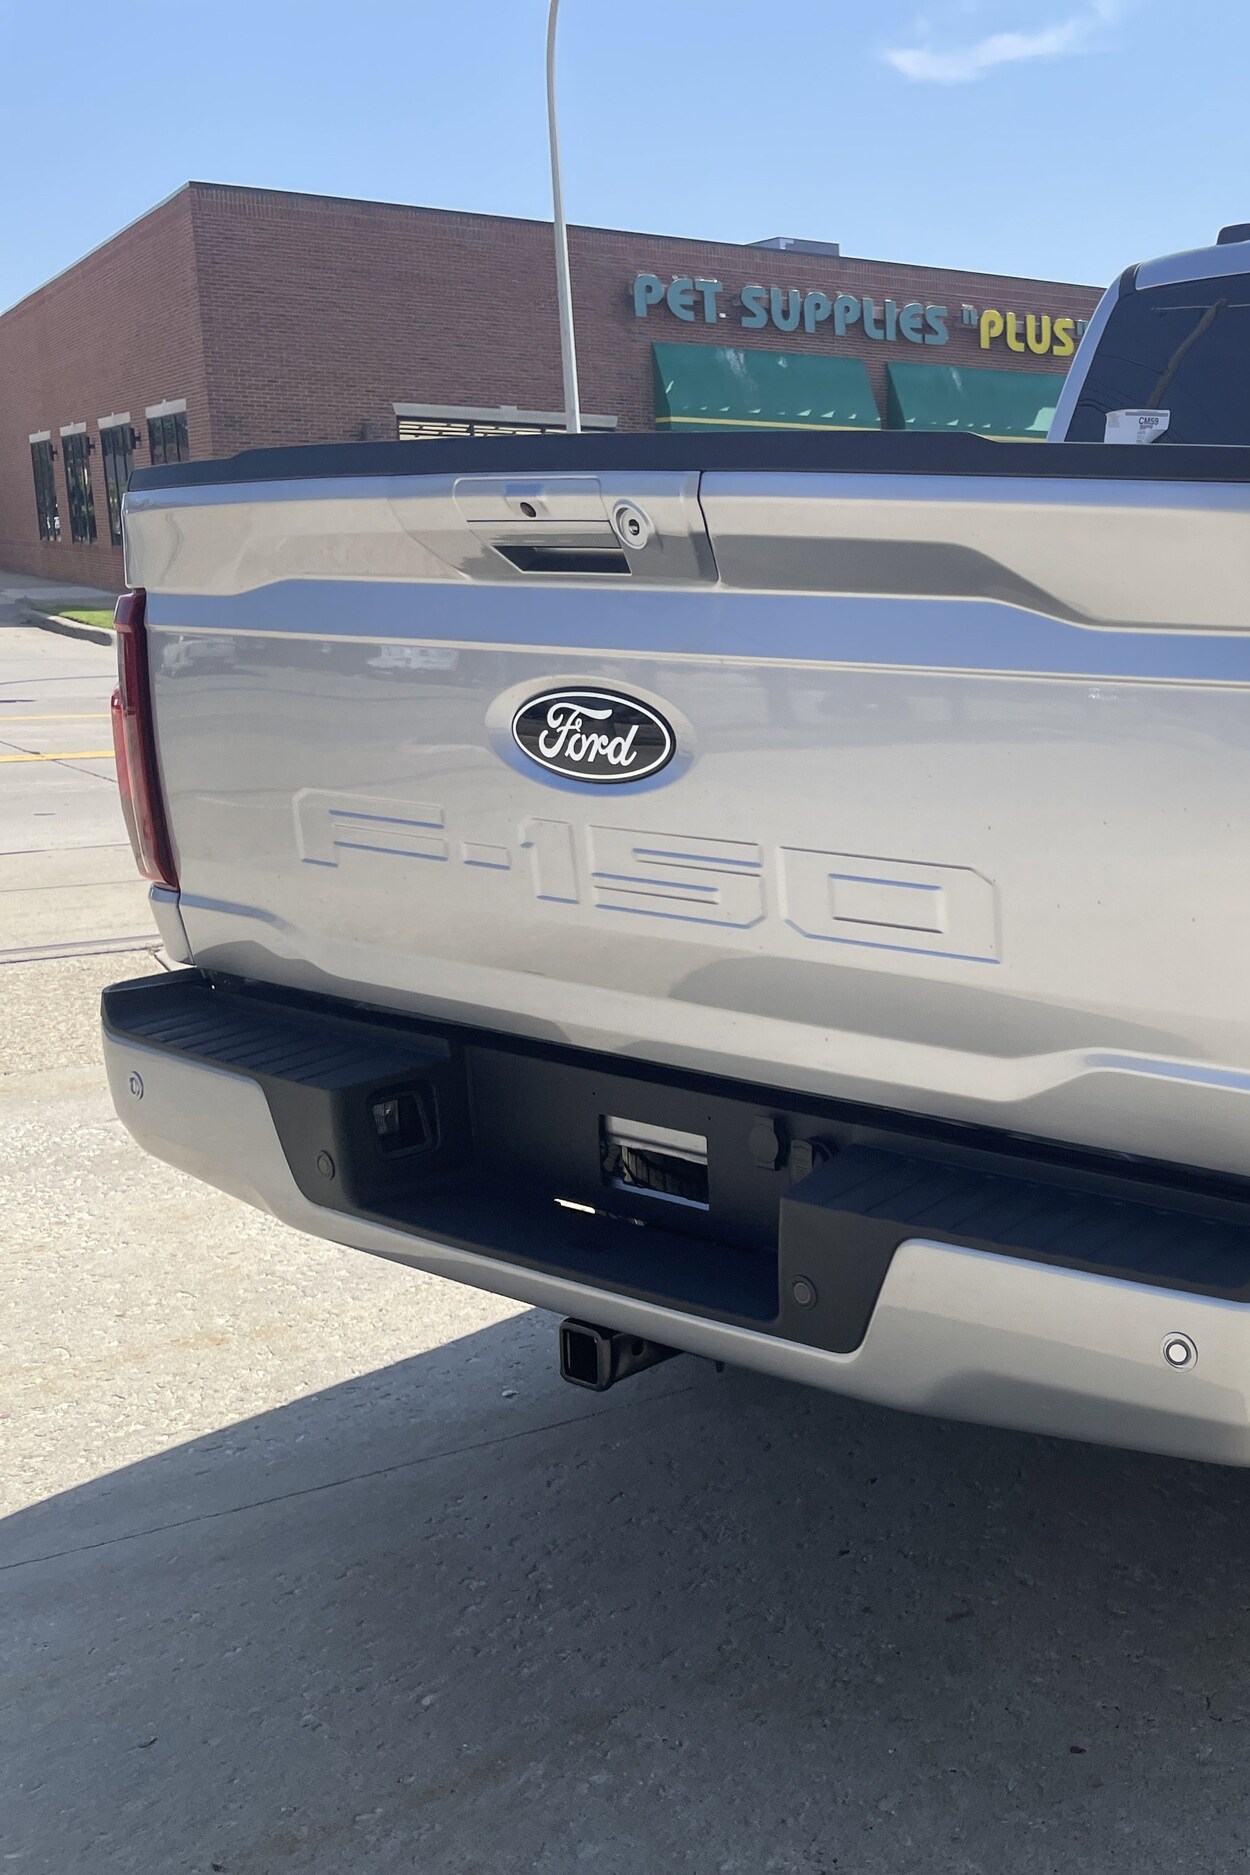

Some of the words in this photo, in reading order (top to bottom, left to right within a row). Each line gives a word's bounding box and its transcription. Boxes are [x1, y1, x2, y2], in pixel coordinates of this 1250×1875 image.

[633, 273, 723, 324] PET
[741, 285, 949, 345] SUPPLIES
[1138, 417, 1159, 426] CM59
[537, 702, 641, 767] Ford
[294, 787, 1001, 964] F-150
